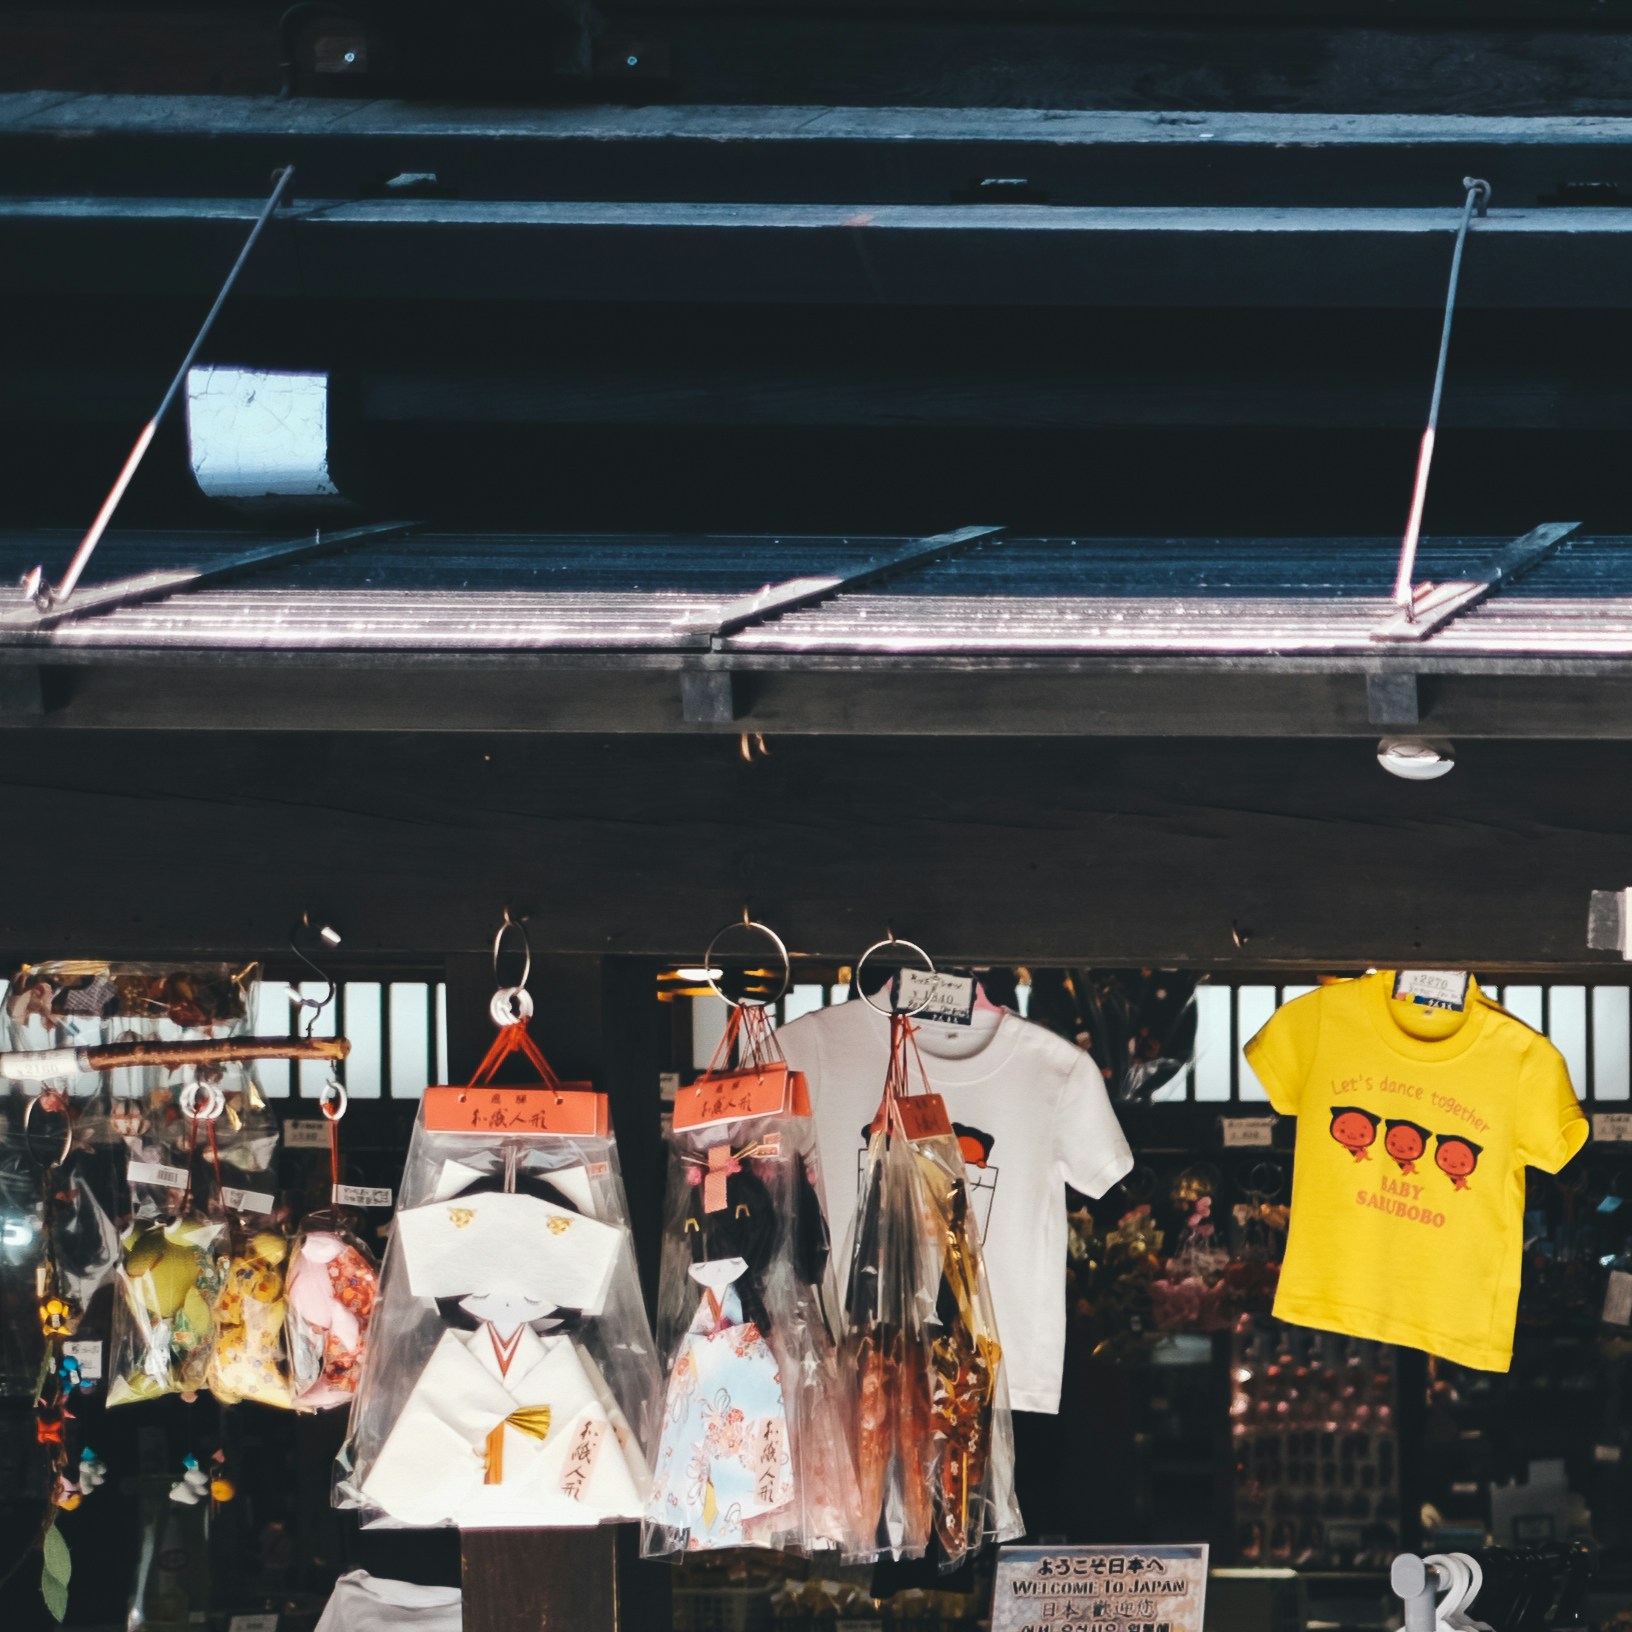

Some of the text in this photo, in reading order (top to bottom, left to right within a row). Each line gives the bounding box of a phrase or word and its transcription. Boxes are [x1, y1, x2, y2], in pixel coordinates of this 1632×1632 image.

[1331, 1074, 1491, 1134] Let's dance together
[1381, 1175, 1425, 1201] BABY
[1356, 1189, 1446, 1229] SARUBOBO
[1038, 1556, 1165, 1576] ようこそ日本へ
[1012, 1579, 1095, 1595] WELCOME
[1128, 1578, 1185, 1594] JAPAN
